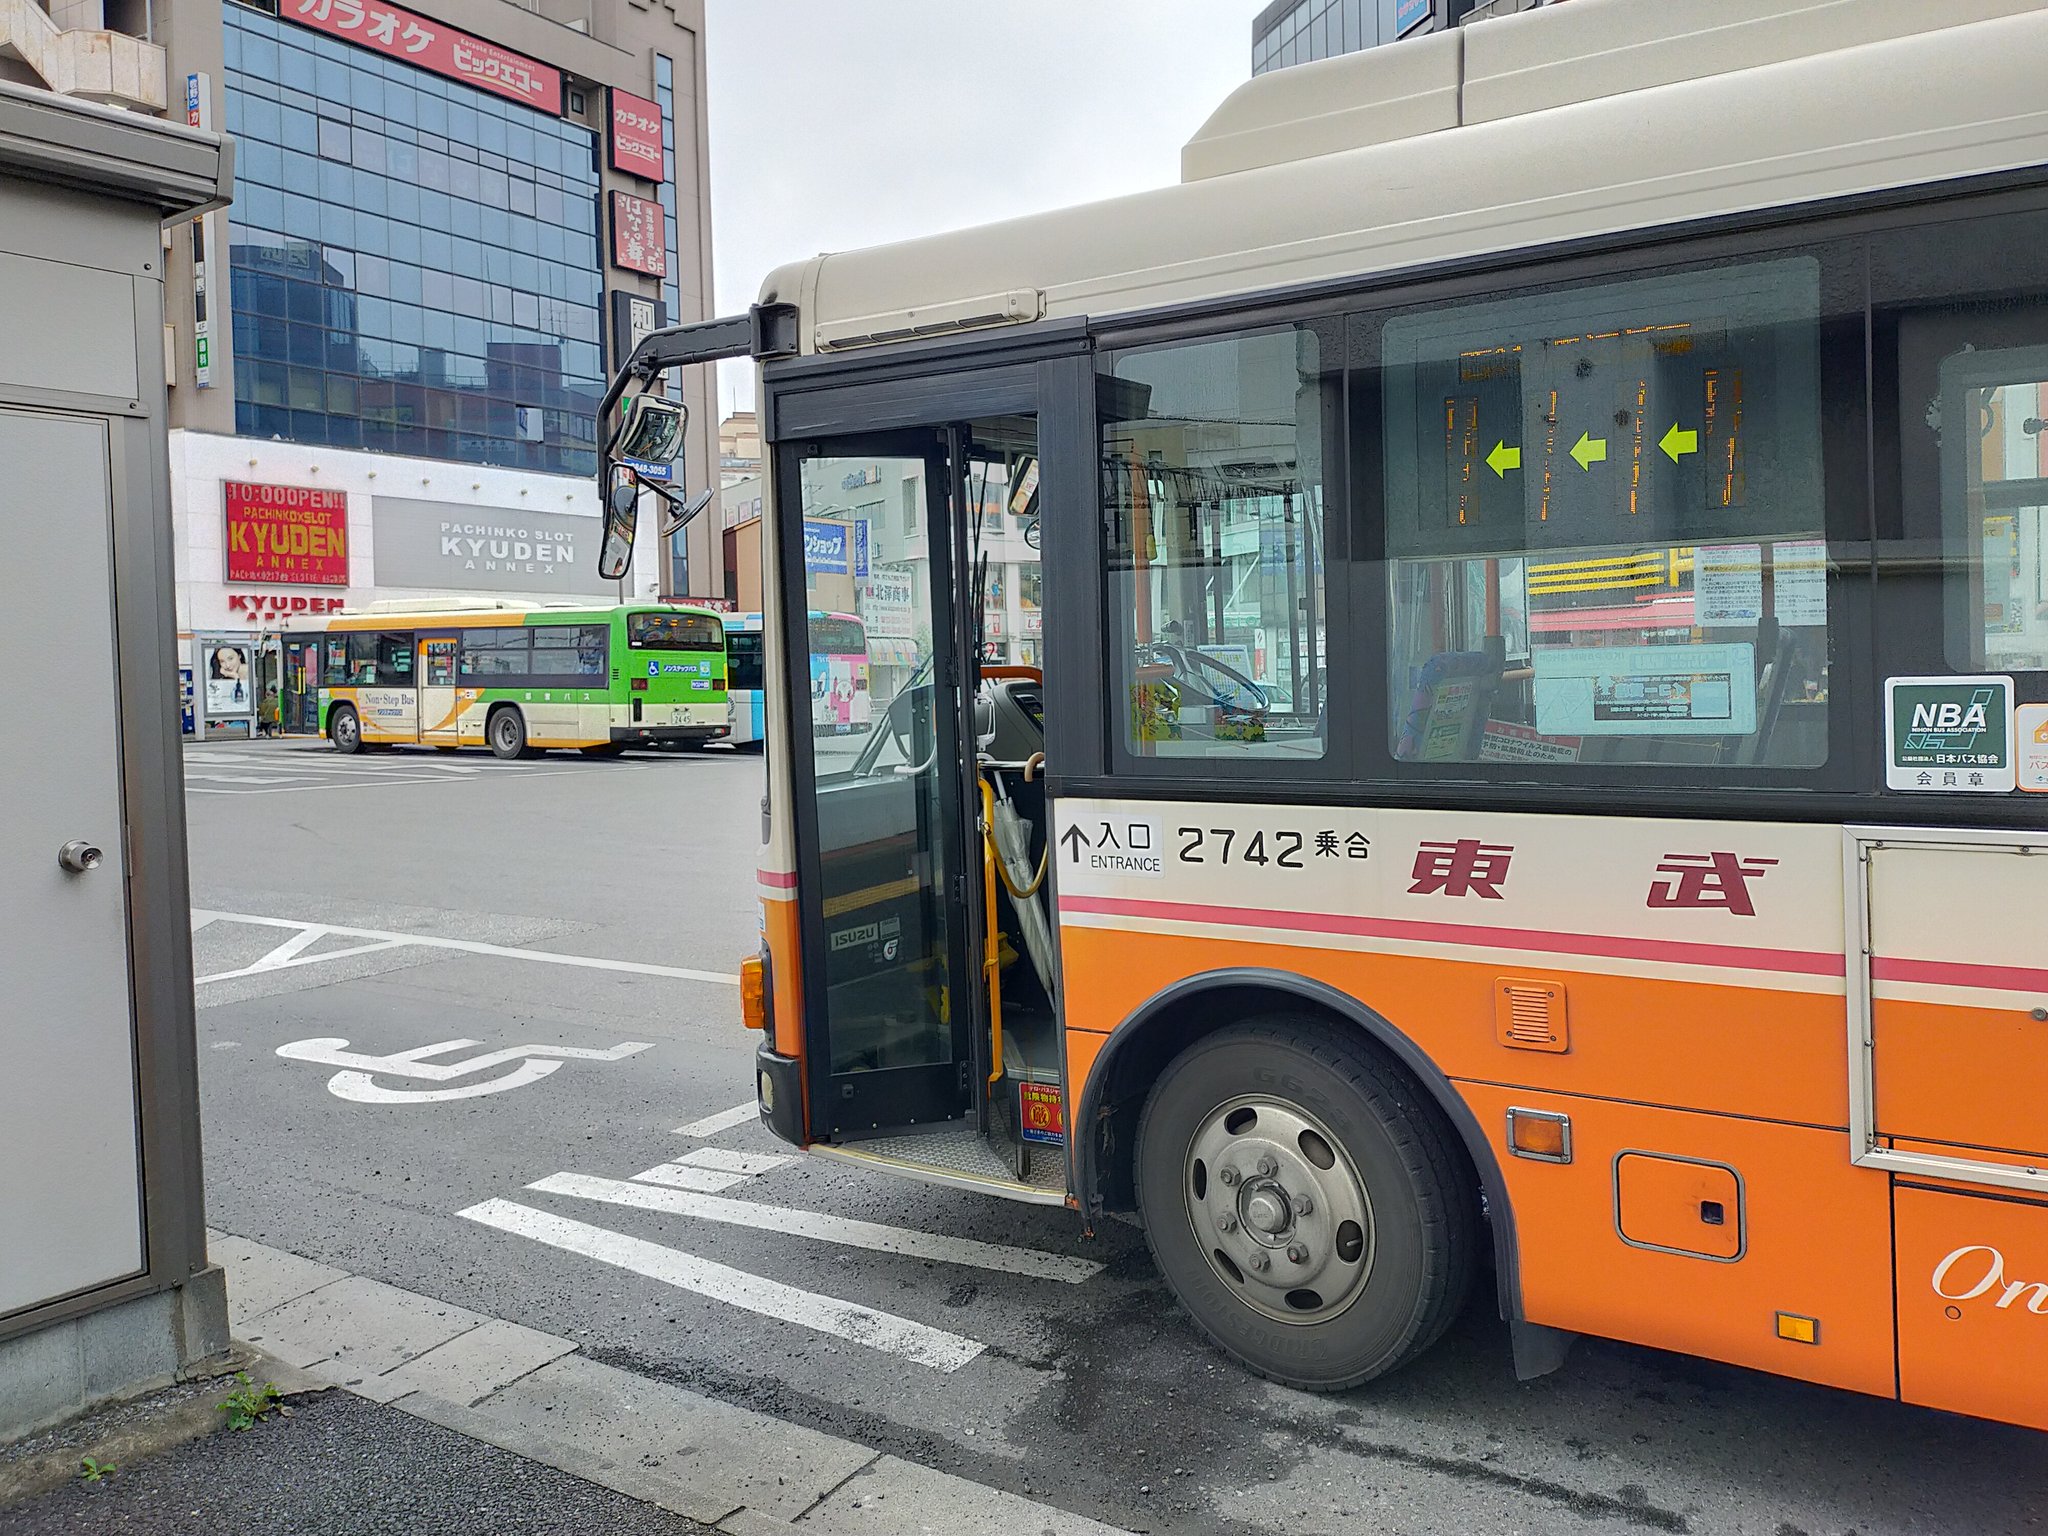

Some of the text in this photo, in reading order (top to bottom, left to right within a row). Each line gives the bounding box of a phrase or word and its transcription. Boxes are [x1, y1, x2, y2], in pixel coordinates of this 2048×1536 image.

[298, 0, 435, 53] カラオケ
[616, 109, 660, 134] カラオケ
[647, 255, 664, 272] 5F
[230, 520, 345, 558] KYUDEN
[441, 522, 574, 542] PACHINKO SLOT
[441, 536, 574, 563] KYUDEN
[256, 555, 323, 570] ANNEX
[465, 560, 554, 574] ANNEX
[228, 594, 345, 613] KYUDEN
[401, 693, 415, 705] Bus
[1912, 703, 1987, 728] NBA
[1936, 754, 1999, 764] 日本バス協会
[1916, 771, 1985, 787] 会員章
[1097, 821, 1151, 850] 入口
[1178, 827, 1371, 869] 2742 乗合
[1091, 854, 1161, 872] ENTRANCE
[835, 927, 874, 947] ISUZU
